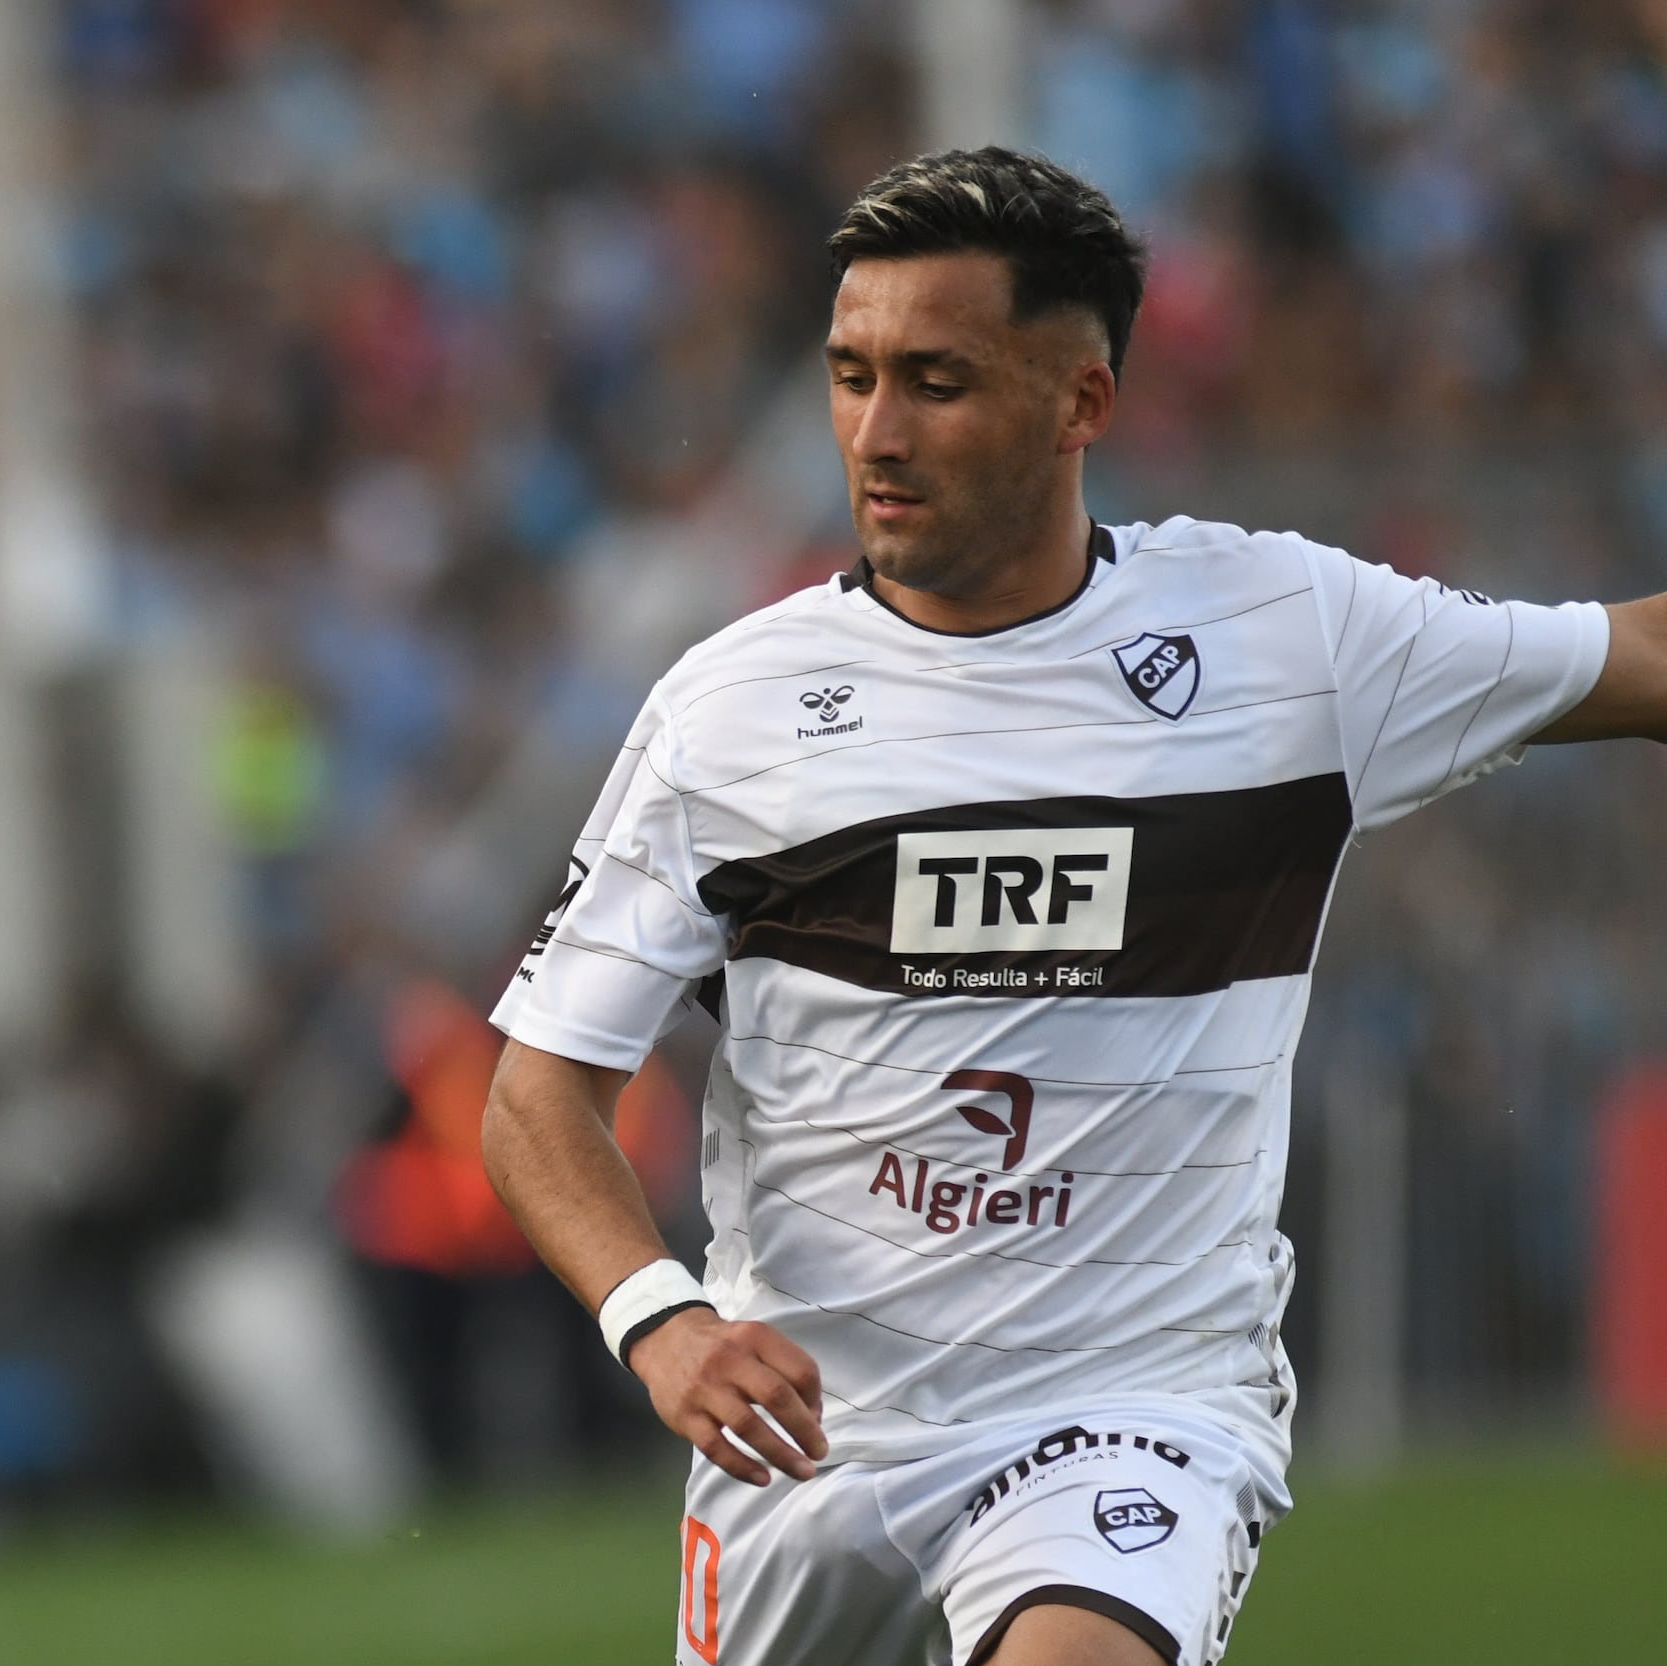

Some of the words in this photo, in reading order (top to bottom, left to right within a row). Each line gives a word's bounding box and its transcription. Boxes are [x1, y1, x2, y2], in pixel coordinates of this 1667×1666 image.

[1138, 645, 1181, 689] CAP
[797, 715, 863, 740] hummel
[919, 854, 1109, 927] TRF
[901, 964, 947, 989] Todo
[953, 968, 1028, 988] Resulta
[1056, 966, 1104, 987] Fácil
[869, 1151, 1075, 1235] Algieri
[1104, 1506, 1162, 1527] CAP
[680, 1514, 721, 1666] 0
